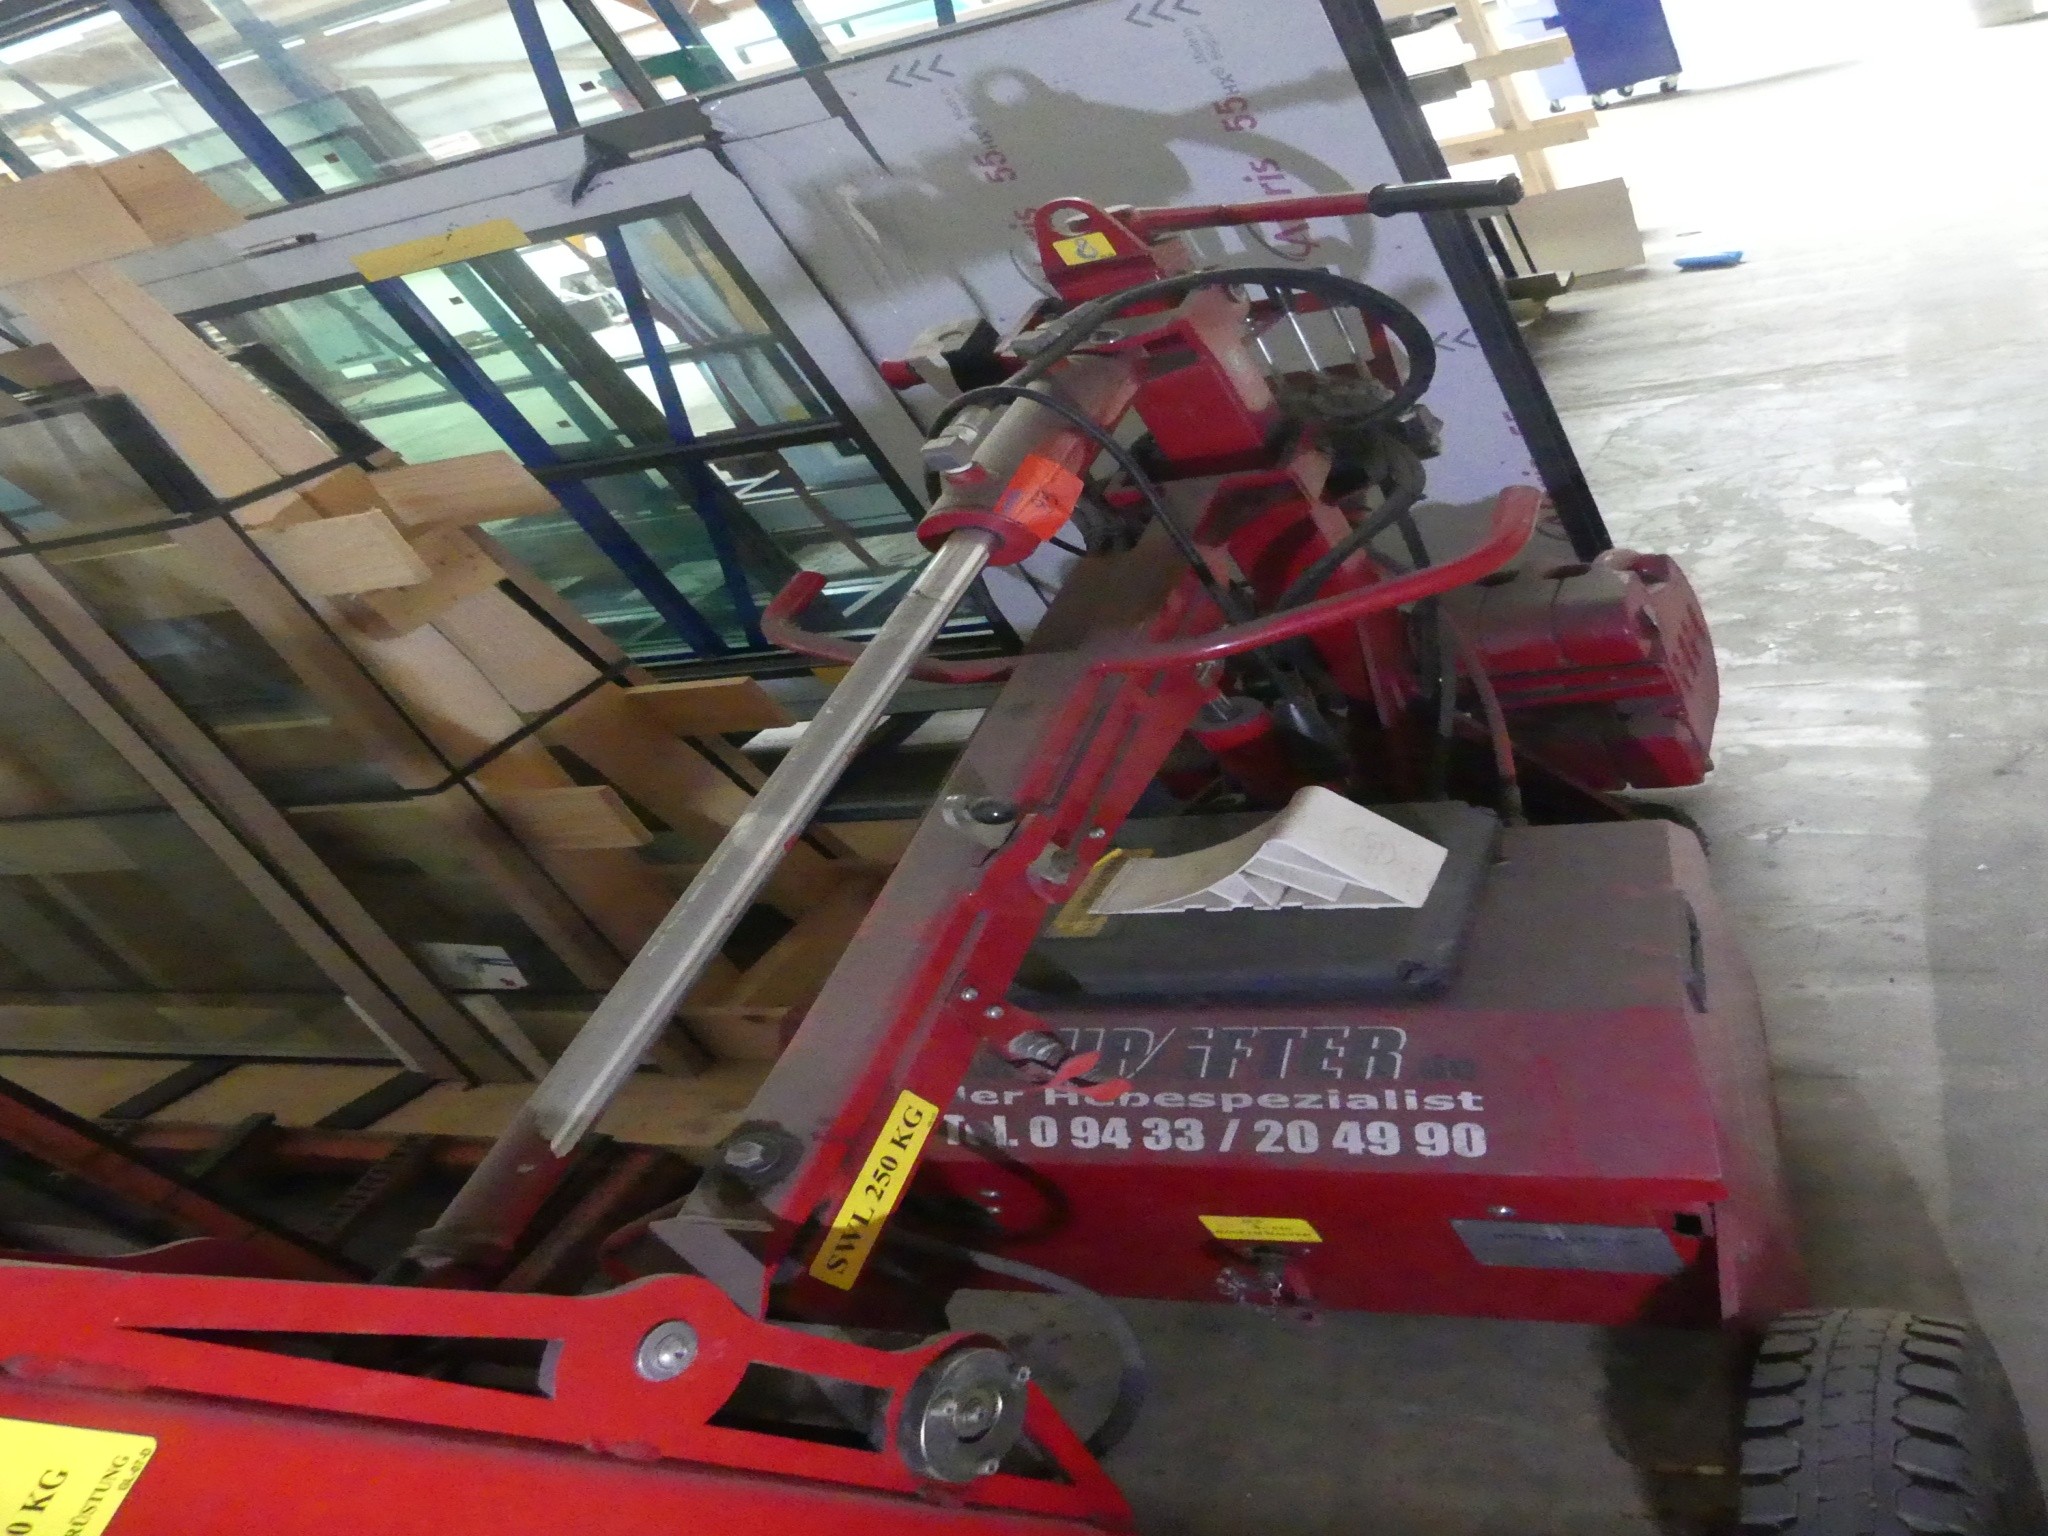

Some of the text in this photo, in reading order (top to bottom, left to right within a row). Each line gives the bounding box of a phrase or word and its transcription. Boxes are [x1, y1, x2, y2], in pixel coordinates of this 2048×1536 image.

[1045, 1087, 1484, 1113] Hbespezialist
[1029, 1115, 1058, 1148] 0
[1070, 1116, 1131, 1149] 94
[1142, 1117, 1205, 1151] 33
[1219, 1118, 1240, 1152] /
[1253, 1119, 1319, 1154] 20
[1332, 1120, 1401, 1156] 49
[1414, 1121, 1487, 1158] 90
[826, 1105, 924, 1275] SWL 250 KG
[20, 1469, 69, 1513] KG
